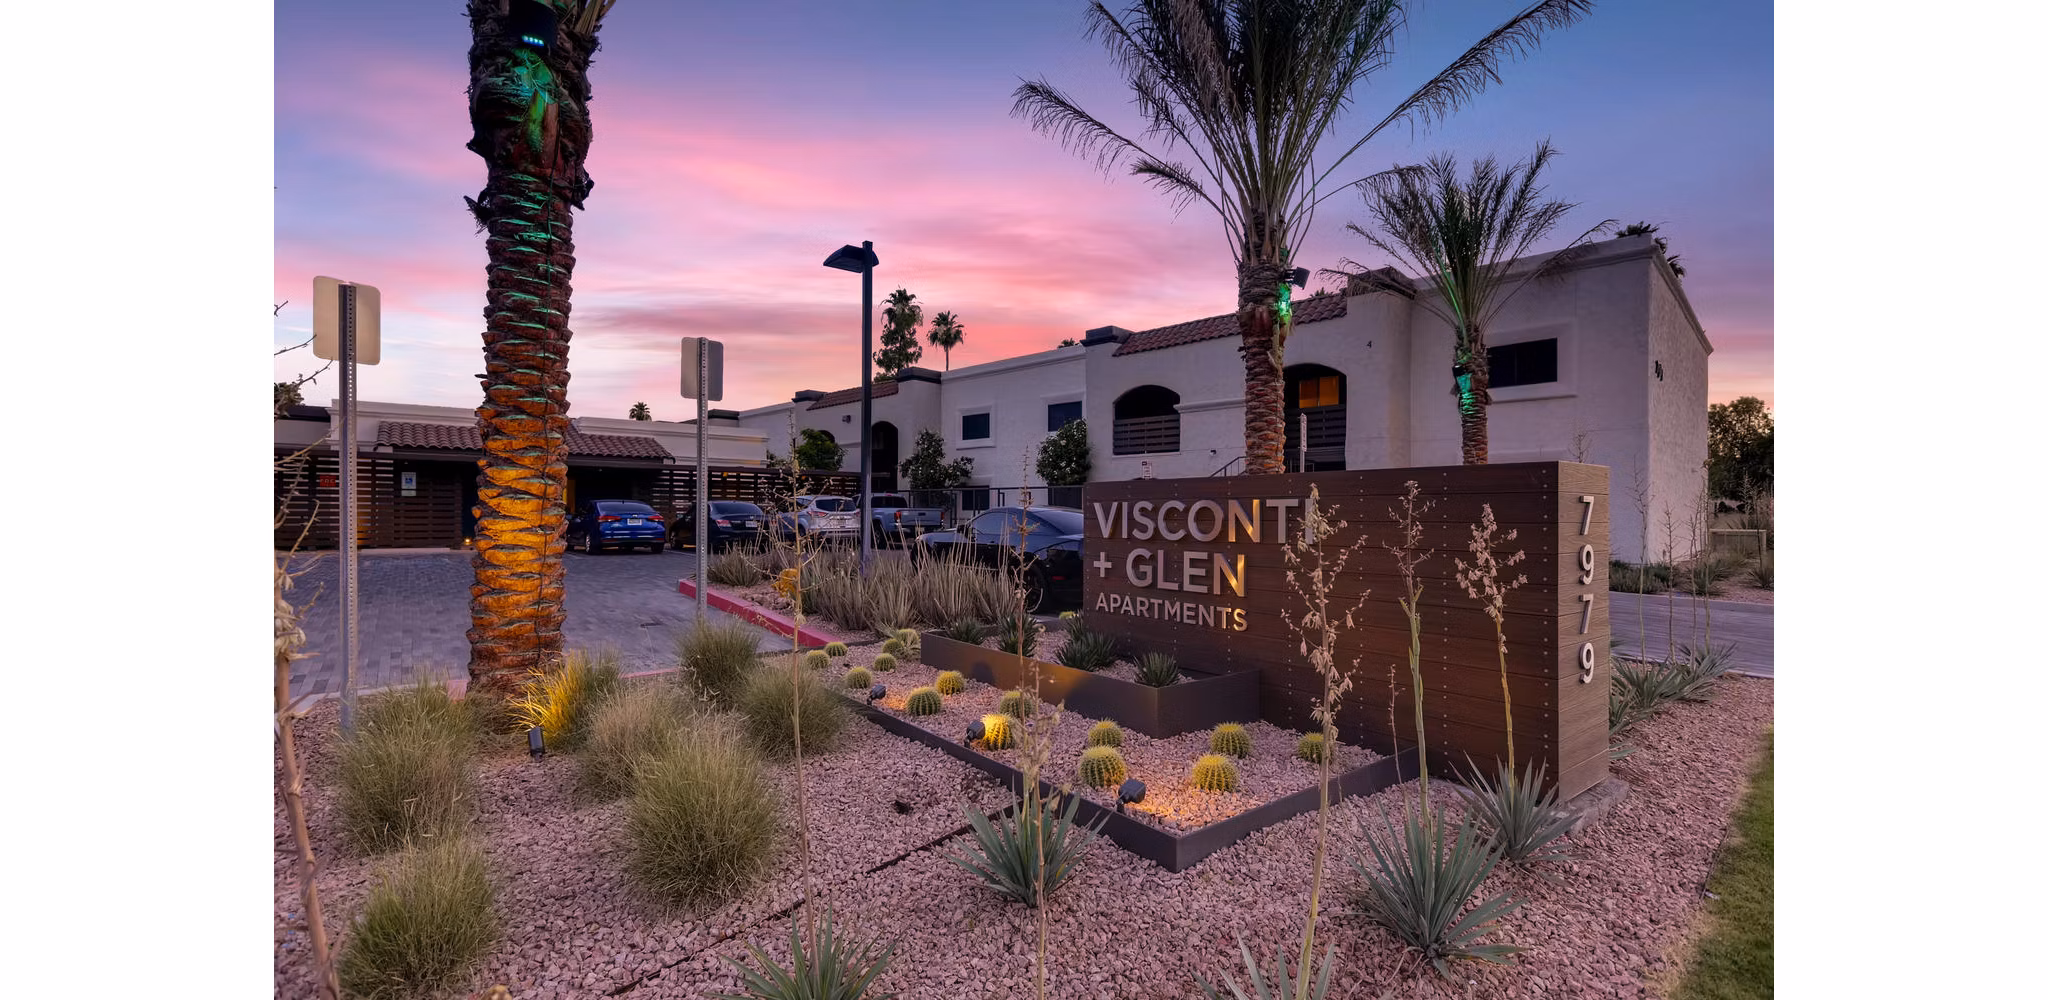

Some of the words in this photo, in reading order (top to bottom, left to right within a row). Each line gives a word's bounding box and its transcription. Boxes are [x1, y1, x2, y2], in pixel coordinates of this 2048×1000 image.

[1093, 499, 1314, 544] VISCONTI
[1093, 551, 1112, 578] +
[1126, 548, 1245, 597] GLEN
[1579, 495, 1595, 684] 7979
[1095, 592, 1248, 632] APARTMENTS
